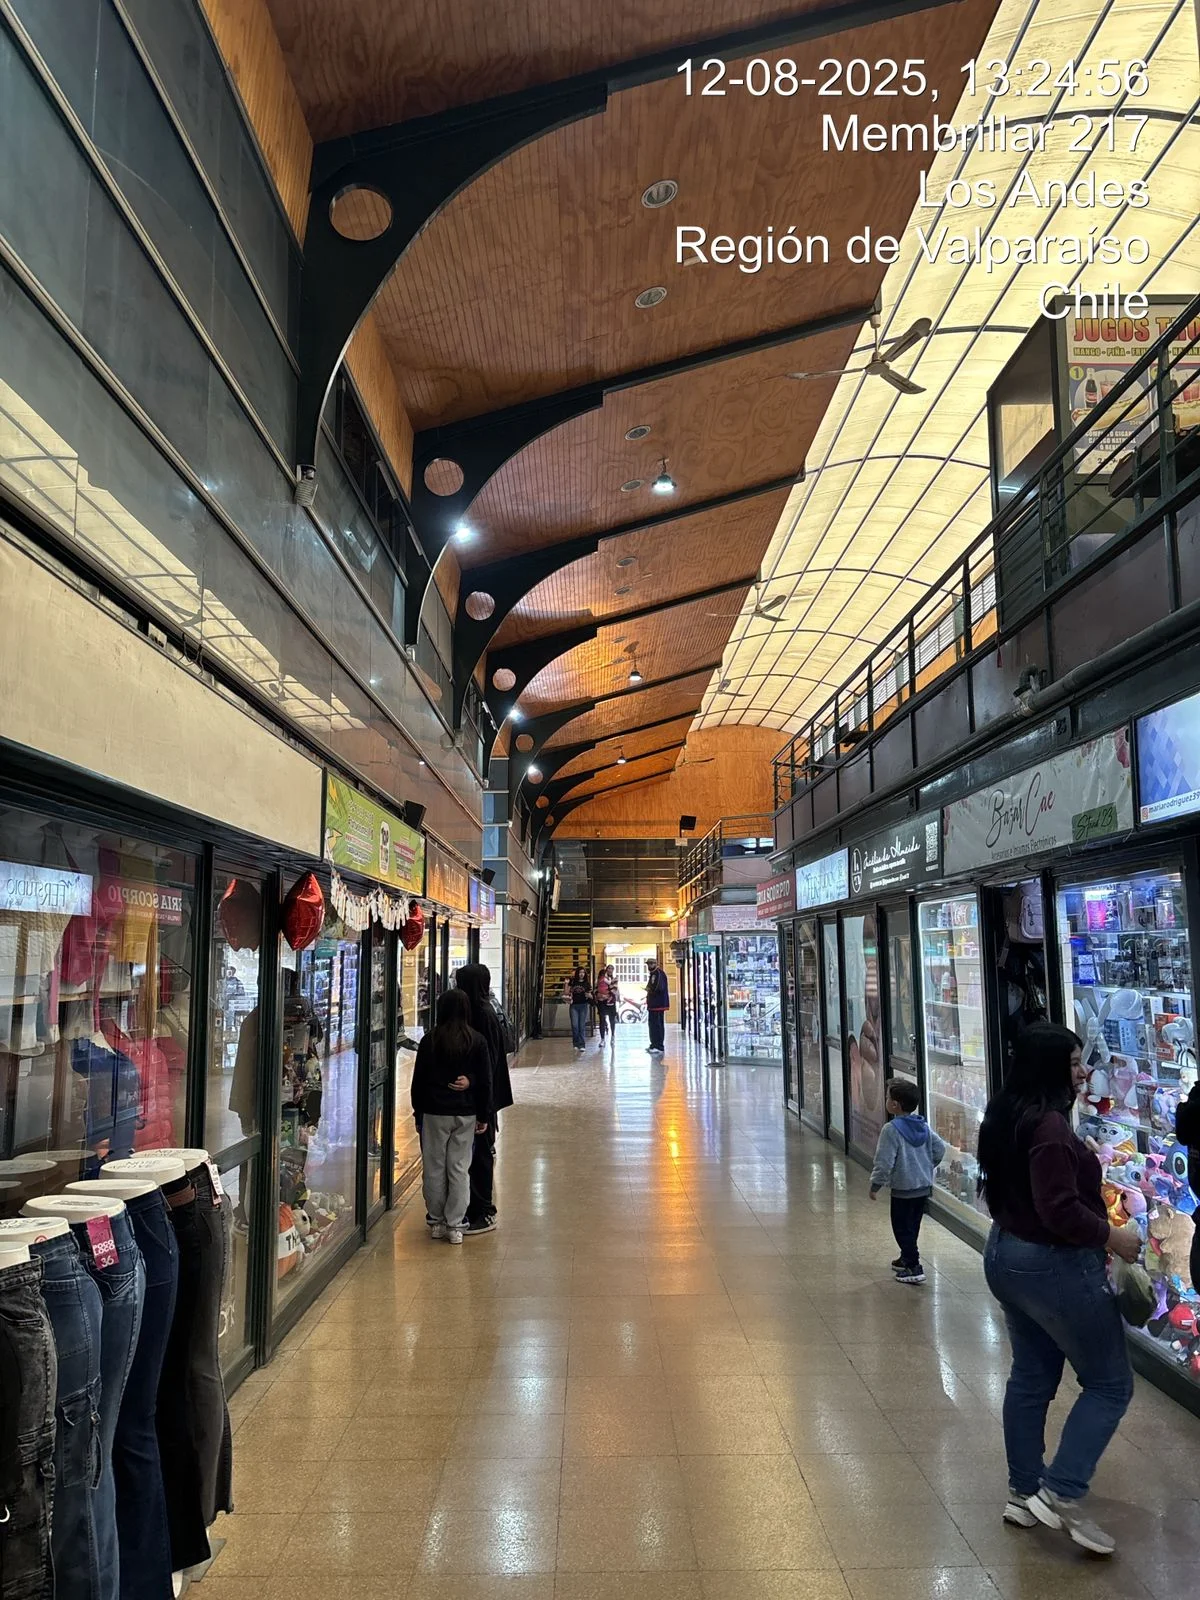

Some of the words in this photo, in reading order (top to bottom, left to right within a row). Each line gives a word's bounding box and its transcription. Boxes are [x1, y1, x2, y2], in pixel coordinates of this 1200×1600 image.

[1073, 317, 1150, 342] JUGOS
[766, 879, 791, 903] SCORPIO
[100, 1255, 115, 1268] 36
